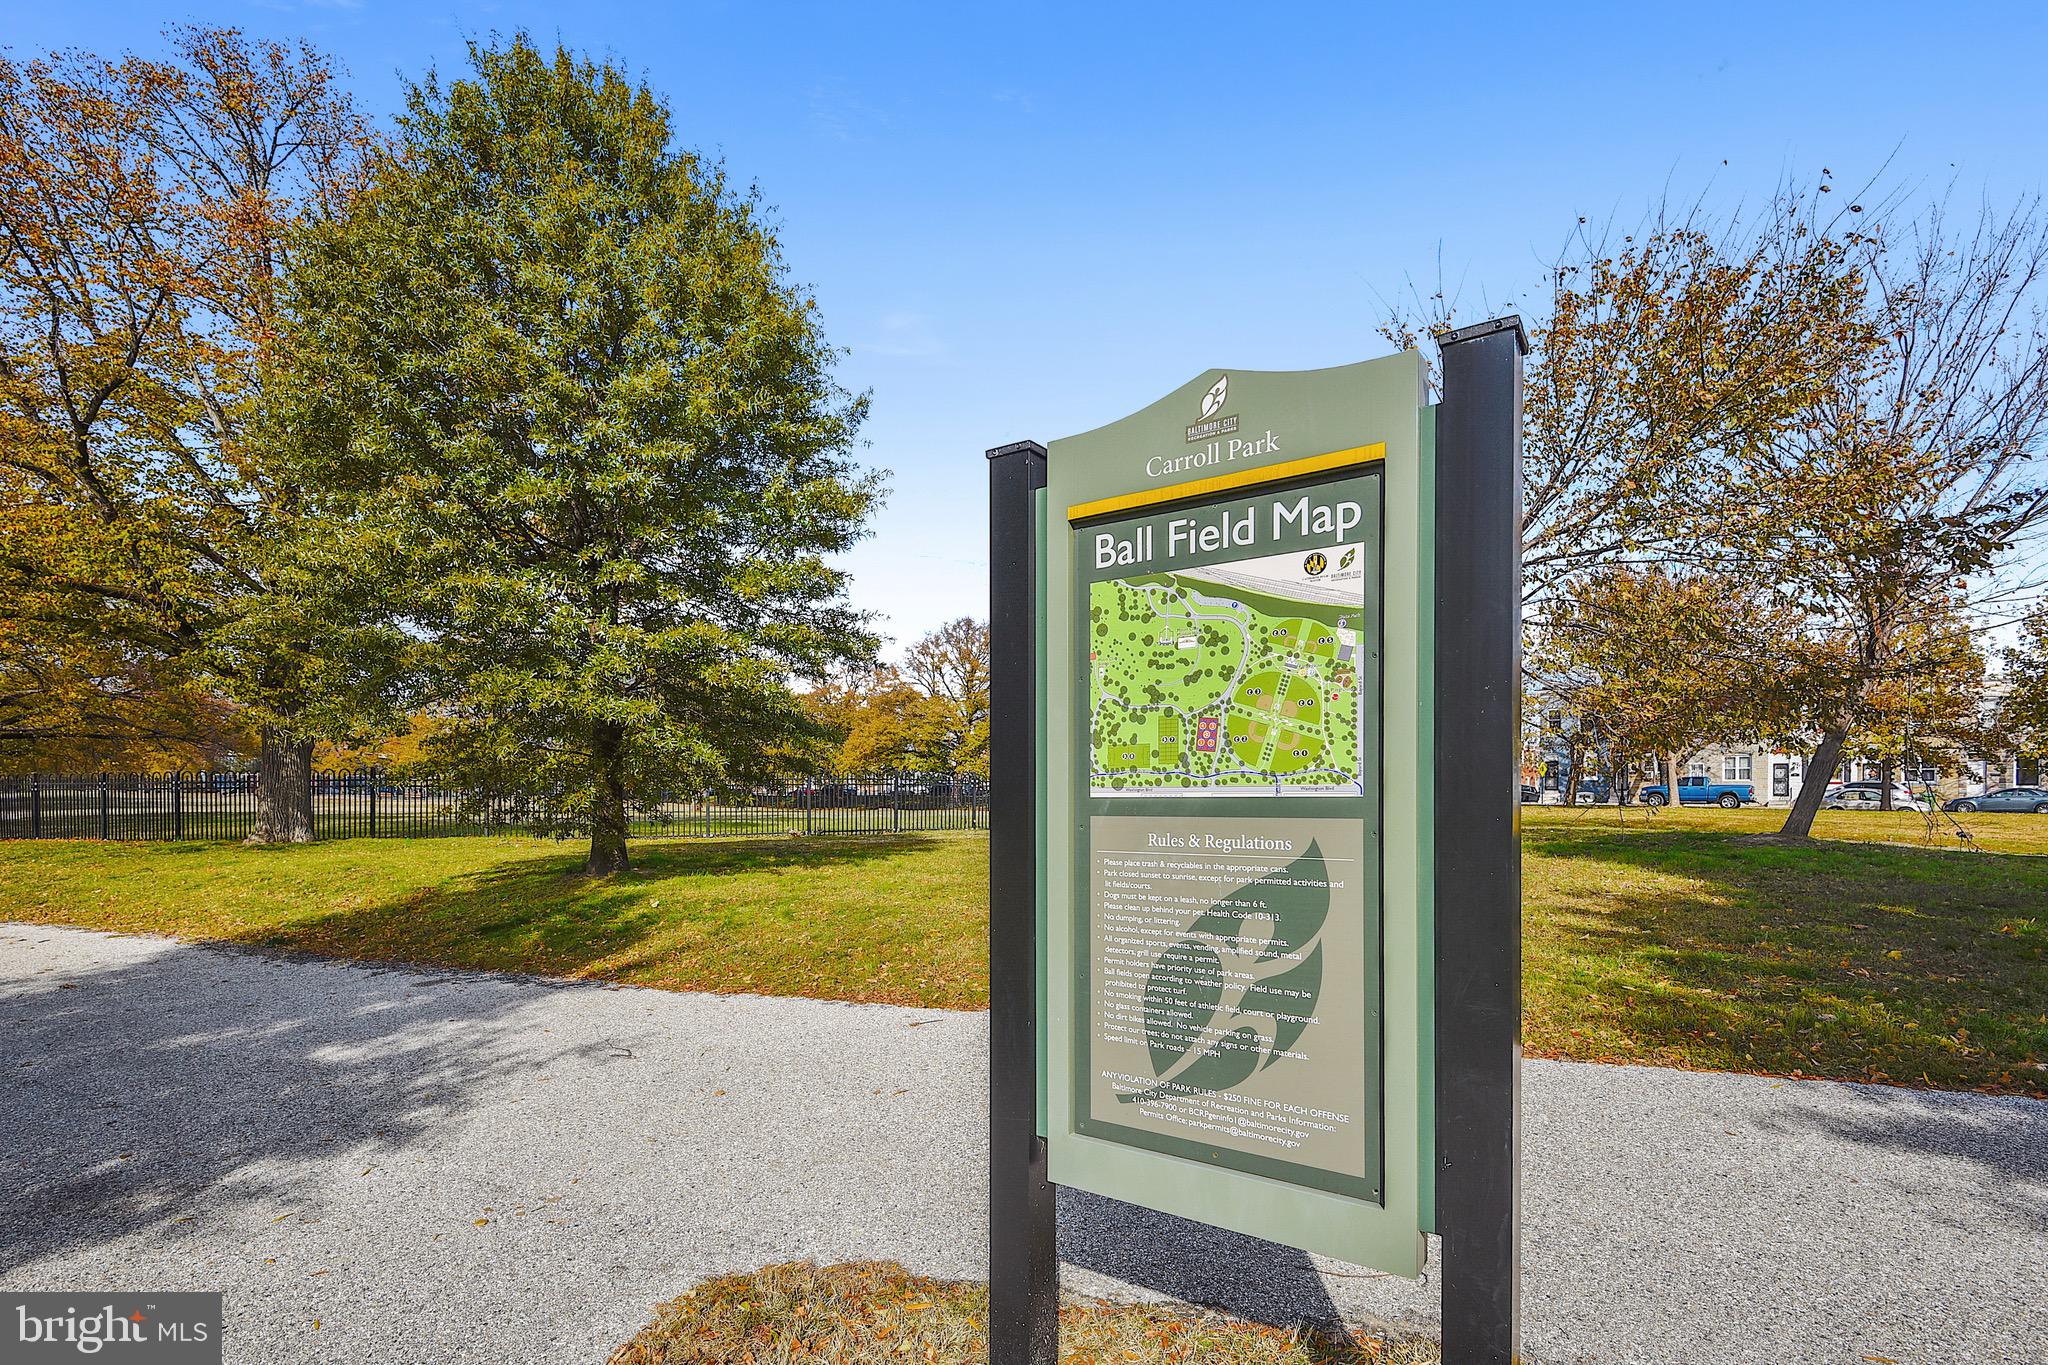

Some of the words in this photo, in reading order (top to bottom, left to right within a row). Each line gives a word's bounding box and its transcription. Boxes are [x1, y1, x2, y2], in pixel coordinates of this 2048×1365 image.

[1188, 420, 1220, 436] BALTIMORE
[1224, 416, 1237, 427] CITY
[1146, 442, 1221, 478] Carroll
[1227, 430, 1280, 461] Park
[1095, 525, 1153, 569] Ball
[1168, 506, 1254, 558] Field
[1272, 496, 1362, 542] Map
[1148, 833, 1184, 847] Rules
[1189, 834, 1200, 848] &
[1205, 835, 1292, 852] Regulations
[1124, 860, 1140, 868] place
[1167, 862, 1203, 870] recyclables
[1226, 864, 1268, 874] appropriate
[1199, 875, 1222, 884] except
[1237, 876, 1252, 885] park
[1255, 877, 1291, 886] permitted
[1293, 879, 1327, 887] activities
[1104, 891, 1120, 901] Dogs
[1148, 894, 1162, 904] kept
[1211, 898, 1233, 908] longer
[1235, 899, 1250, 907] than
[1152, 905, 1173, 914] behind
[1207, 909, 1230, 918] Health
[1232, 911, 1253, 919] Code
[1141, 928, 1162, 937] except
[1216, 935, 1257, 944] appropriate
[1222, 947, 1253, 956] amplified
[1281, 952, 1302, 960] metal
[1116, 969, 1133, 978] fields
[1152, 975, 1183, 985] according
[1194, 979, 1222, 988] weather
[1250, 984, 1268, 993] Field
[1284, 990, 1300, 999] may
[1302, 990, 1311, 998] be
[1116, 993, 1142, 1003] smoking
[1143, 995, 1162, 1004] within
[1174, 998, 1188, 1007] feet
[1198, 1002, 1223, 1012] athletic
[1116, 1002, 1130, 1011] glass
[1132, 1006, 1165, 1015] containers
[1104, 1011, 1114, 1019] No
[1115, 1013, 1127, 1021] dirt
[1129, 1015, 1145, 1024] bikes
[1177, 1022, 1188, 1030] No
[1189, 1024, 1212, 1034] vehicle
[1214, 1028, 1240, 1040] parking
[1104, 1022, 1127, 1032] Protect
[1185, 1035, 1205, 1044] attach
[1207, 1039, 1219, 1048] any
[1221, 1040, 1237, 1050] signs
[1250, 1045, 1271, 1054] other
[1104, 1033, 1122, 1043] Speed
[1124, 1036, 1138, 1045] limit
[1150, 1040, 1164, 1049] Park
[1166, 1044, 1184, 1052] roads
[1193, 1047, 1201, 1055] 15
[1204, 1049, 1221, 1058] MPH
[1102, 1070, 1117, 1079] ANY
[1117, 1073, 1157, 1087] VIOLATION
[1160, 1081, 1170, 1089] OF
[1172, 1083, 1192, 1093] PARK
[1194, 1087, 1216, 1098] RULES
[1224, 1092, 1241, 1102] $250
[1244, 1096, 1261, 1106] FINE
[1264, 1100, 1280, 1110] FOR
[1284, 1103, 1307, 1115] EACH
[1310, 1108, 1349, 1123] OFFENSE
[1112, 1083, 1142, 1095] Baltimore
[1144, 1088, 1157, 1099] City
[1160, 1092, 1200, 1106] Department
[1211, 1101, 1249, 1115] Recreation
[1266, 1112, 1287, 1123] Parks
[1132, 1097, 1177, 1112] 410-396-7900
[1140, 1108, 1163, 1120] Permits
[1189, 1120, 1300, 1148] parkpermits@baltimorecity.gov
